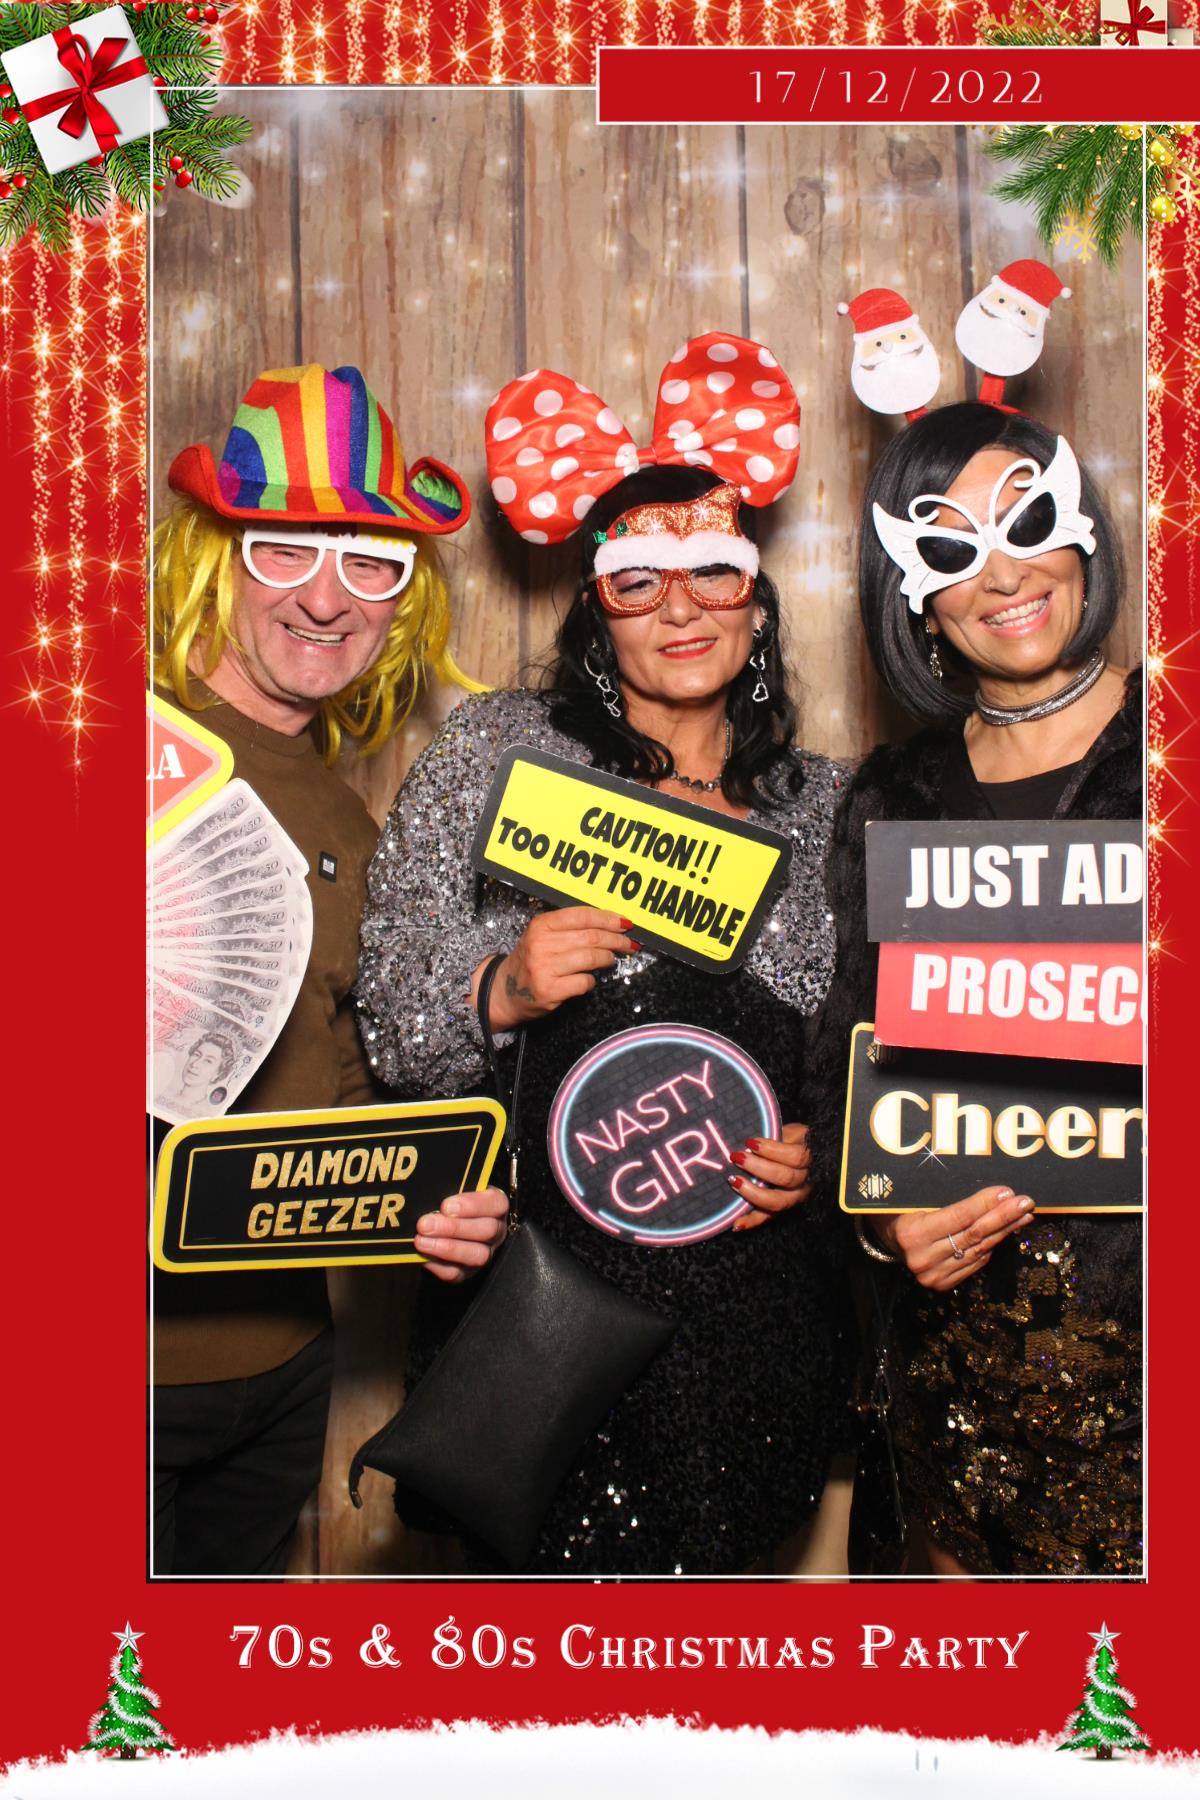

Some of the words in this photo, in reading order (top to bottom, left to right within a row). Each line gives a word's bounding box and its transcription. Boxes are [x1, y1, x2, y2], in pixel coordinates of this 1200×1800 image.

[580, 806, 722, 885] CAUTION!!
[905, 845, 1049, 909] JUST
[498, 816, 550, 860] TOO
[549, 839, 608, 885] HOT
[606, 860, 642, 900] TO
[639, 876, 746, 948] HANDLE
[910, 953, 1148, 1027] PROSEC
[575, 1060, 715, 1164] NASTY
[869, 1090, 1148, 1160] Cheer
[250, 1145, 419, 1190] DIAMOND
[247, 1193, 406, 1239] GEEZER
